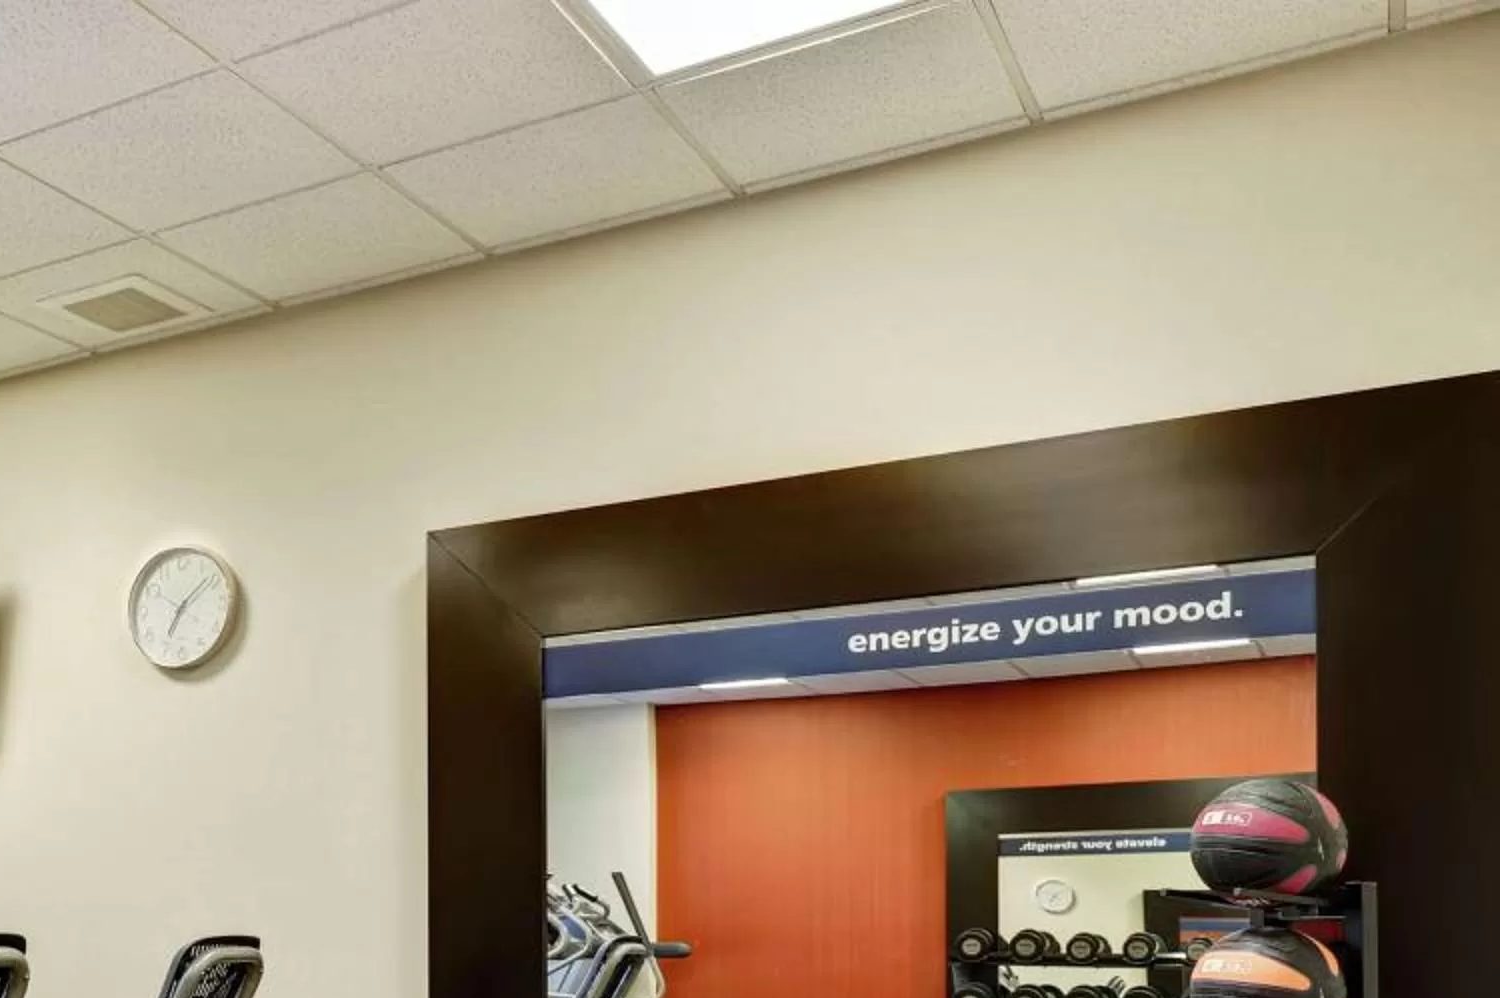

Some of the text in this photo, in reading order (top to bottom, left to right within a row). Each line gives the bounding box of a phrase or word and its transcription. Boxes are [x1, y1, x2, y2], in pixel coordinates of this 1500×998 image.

[847, 591, 1243, 653] energize your mood.
